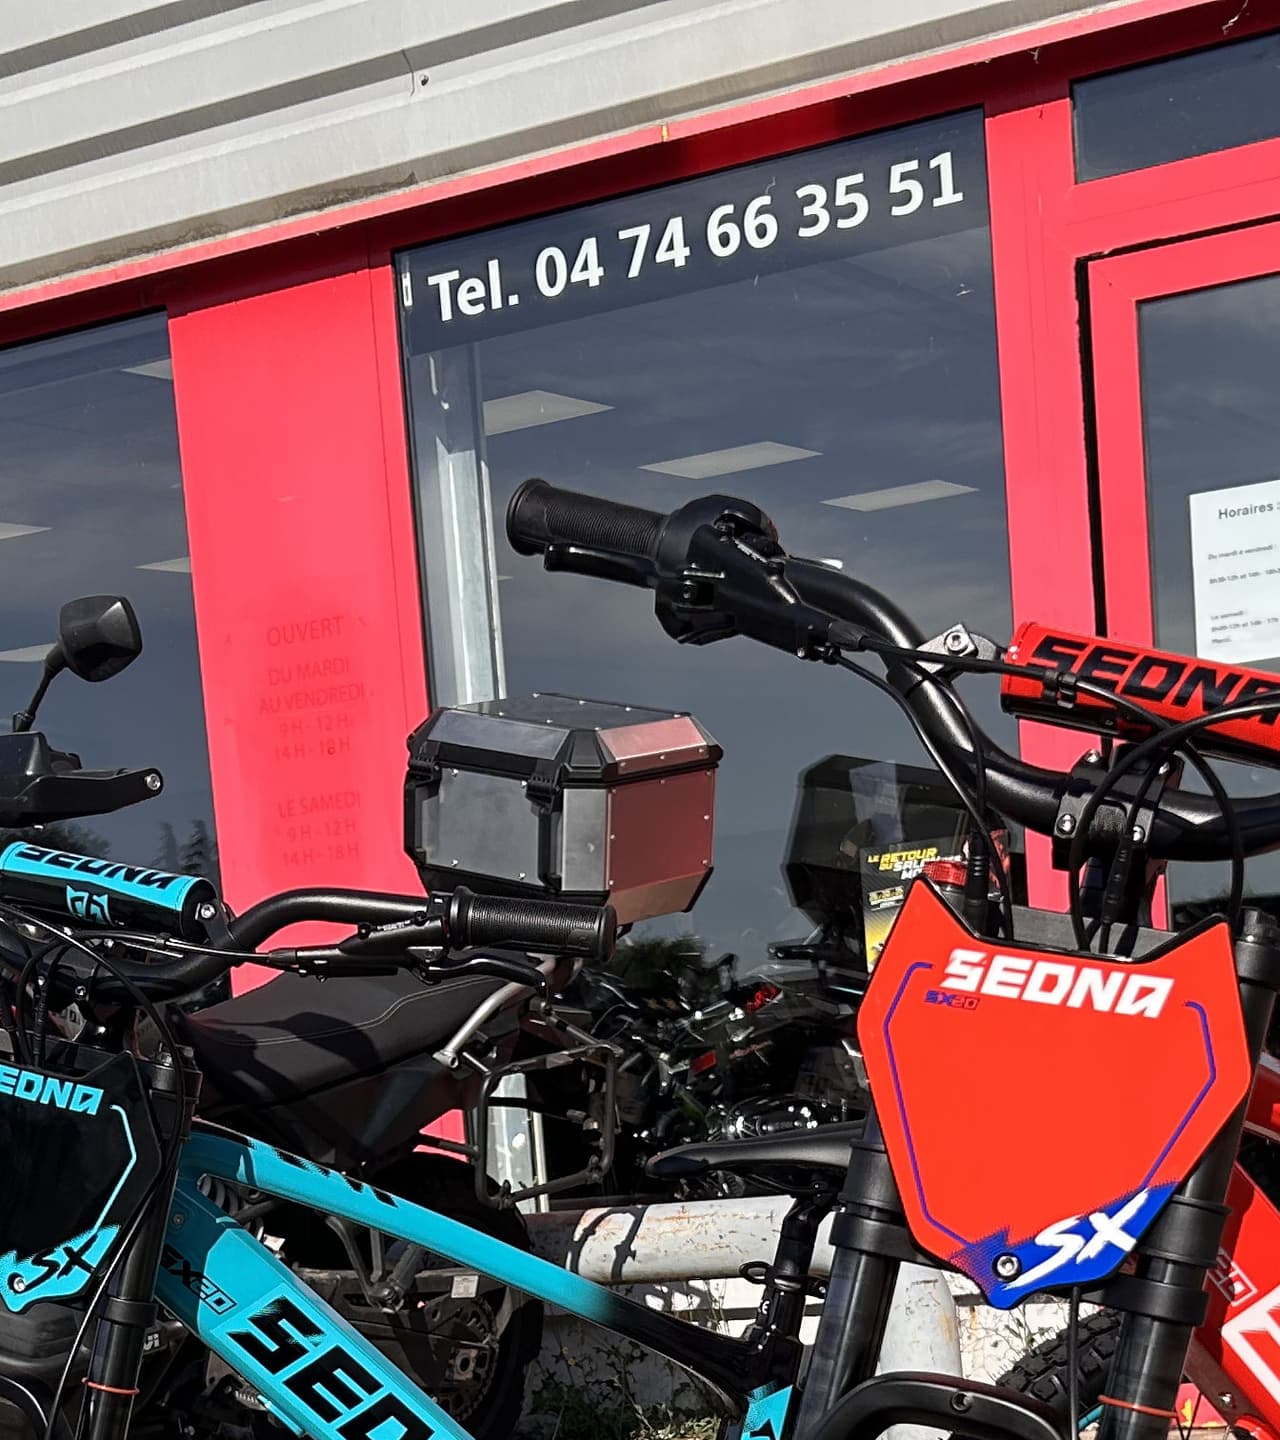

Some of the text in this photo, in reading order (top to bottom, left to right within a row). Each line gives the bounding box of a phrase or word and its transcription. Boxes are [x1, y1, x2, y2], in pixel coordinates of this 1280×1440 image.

[428, 151, 964, 321] Tel. 04 74 66 35 51
[1218, 503, 1274, 520] Horaires
[267, 616, 344, 647] OUVERT
[282, 682, 366, 712] VENDREDI
[880, 847, 938, 864] RETOUR
[924, 990, 981, 1011] SX20
[1006, 1187, 1152, 1292] SX
[14, 1233, 99, 1294] SX
